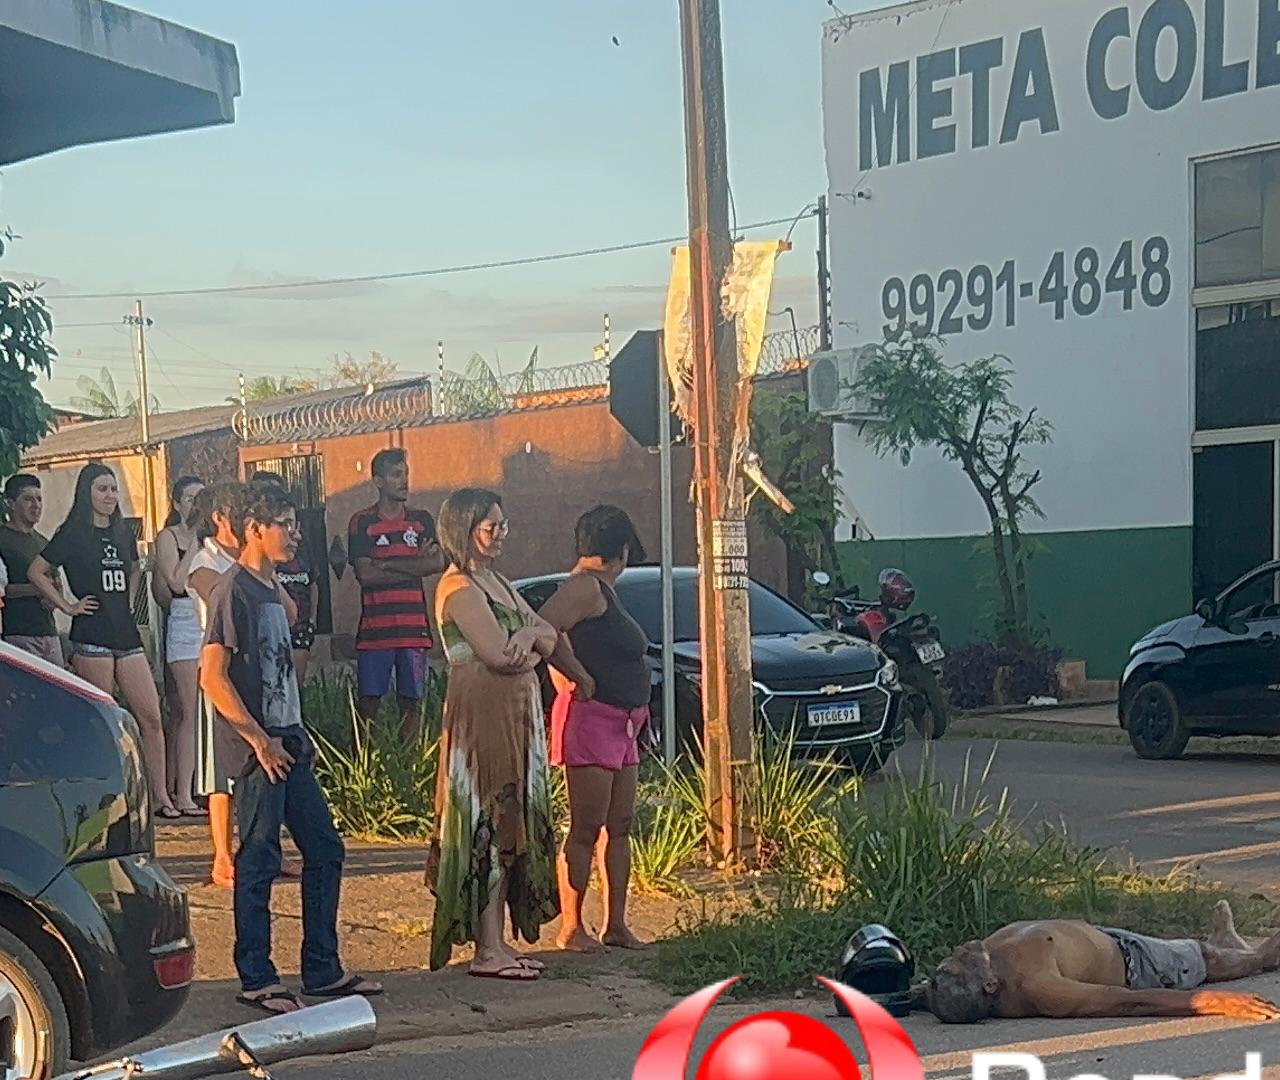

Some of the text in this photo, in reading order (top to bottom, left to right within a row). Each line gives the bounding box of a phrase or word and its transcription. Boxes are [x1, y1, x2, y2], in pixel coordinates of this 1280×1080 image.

[859, 27, 1060, 171] META
[881, 236, 1171, 342] 99291-4848
[102, 570, 126, 592] 09
